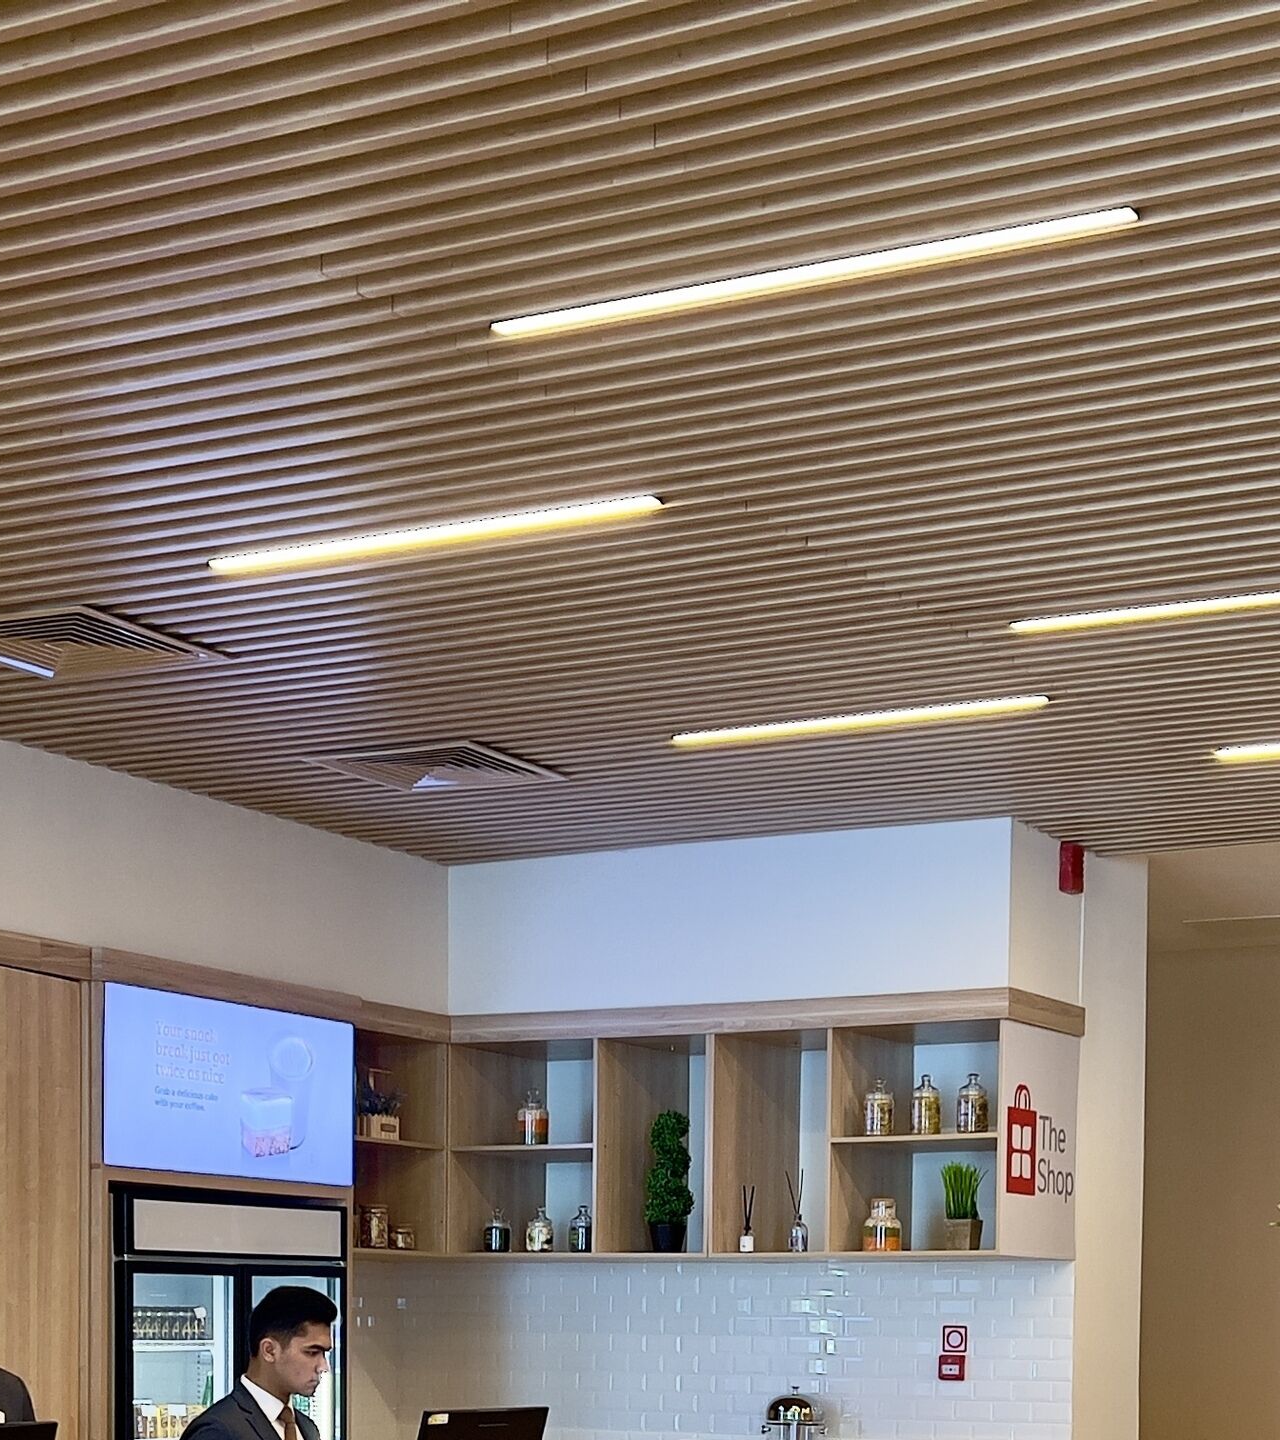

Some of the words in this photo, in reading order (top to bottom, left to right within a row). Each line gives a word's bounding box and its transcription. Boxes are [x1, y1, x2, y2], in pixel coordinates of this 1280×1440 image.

[154, 1020, 183, 1039] Your
[155, 1040, 188, 1060] break
[189, 1045, 211, 1064] just
[212, 1051, 230, 1068] got
[154, 1063, 186, 1080] twice
[187, 1068, 200, 1081] as
[202, 1067, 225, 1085] nice
[1039, 1115, 1066, 1153] The
[1037, 1158, 1074, 1203] Shop
